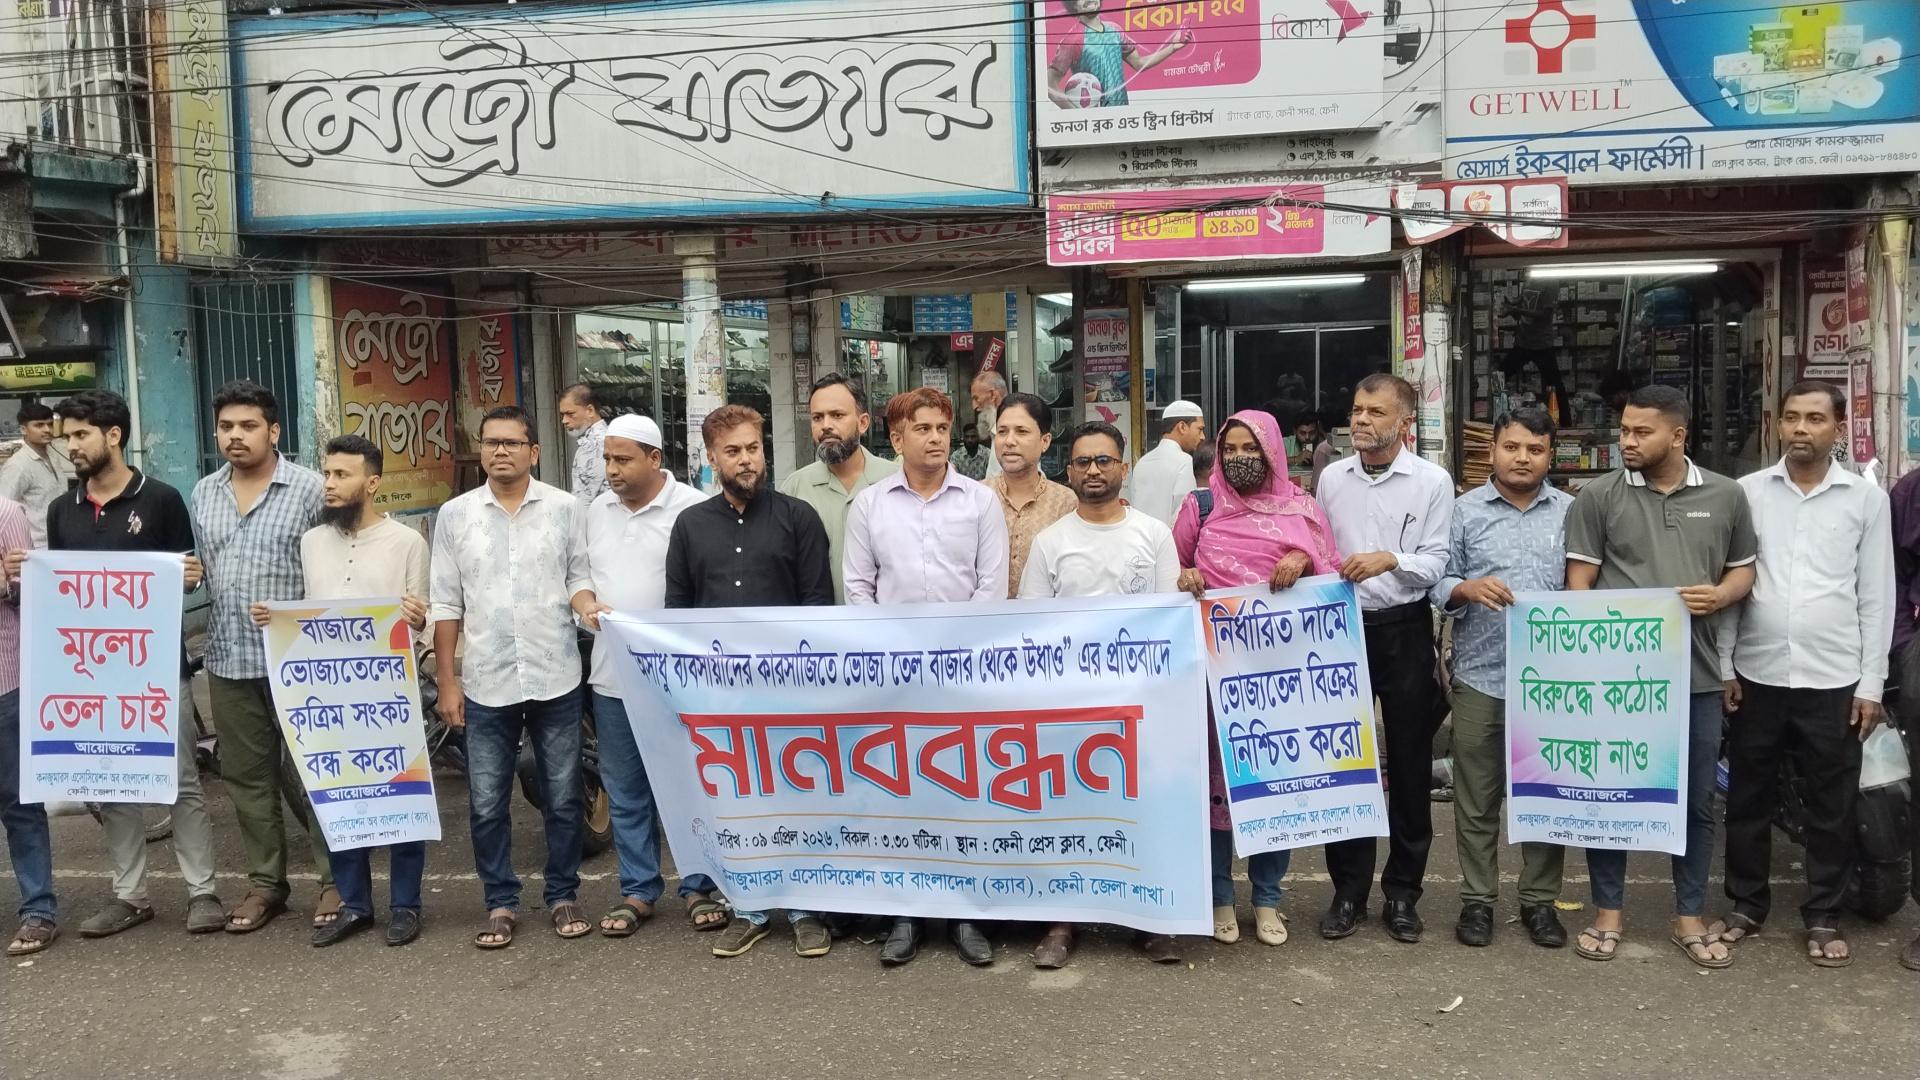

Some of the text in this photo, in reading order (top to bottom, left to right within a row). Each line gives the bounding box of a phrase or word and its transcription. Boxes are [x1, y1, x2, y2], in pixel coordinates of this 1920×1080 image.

[1272, 12, 1330, 39] বিকাশ
[267, 28, 996, 187] মেট্রো বাজার
[1050, 119, 1087, 134] জনতা
[1091, 118, 1114, 134] ব্লক
[1118, 115, 1141, 129] এন্ড
[1171, 108, 1213, 127] প্রিন্টার্স
[1469, 88, 1631, 117] GETWELL
[1457, 135, 1693, 180] মেসার্স ইকবাল ফার্মেসী
[192, 120, 222, 255] বাজার
[340, 292, 443, 384] মেট্রো
[478, 318, 504, 403] বাজার
[346, 400, 452, 466] বাজার
[53, 566, 156, 610] ন্যায্য
[297, 617, 376, 645] বাজারে
[1210, 599, 1350, 655] নির্ধারিত দামে
[1526, 605, 1665, 655] সিন্ডিকেটরের
[56, 627, 155, 680] মূল্যে
[281, 656, 407, 687] ভোজ্যতেলের
[672, 639, 753, 688] ব্যবসায়ীদের
[755, 639, 838, 688] কারসাজিতে
[843, 648, 885, 688] ভোজ্য
[890, 649, 924, 688] তেল
[928, 646, 974, 688] বাজার
[979, 641, 1018, 684] থেকে
[1078, 642, 1101, 680] এর
[1106, 627, 1171, 680] প্রতিবাদে
[1219, 651, 1359, 715] ভোজ্যতেল বিক্রয়
[1520, 664, 1671, 715] বিরুদ্ধে কঠোর
[39, 682, 171, 735] তেল চাই
[286, 692, 411, 746] কৃত্রিম সংকট
[303, 744, 406, 780] বন্ধ করো
[678, 705, 1144, 814] মানববন্ধন
[1228, 717, 1363, 777] নিশ্চিত করো
[1537, 736, 1648, 782] ব্যবস্থা নাও
[67, 785, 89, 797] ফেনী
[92, 788, 116, 797] জেলা
[350, 832, 376, 843] জেলা
[771, 825, 799, 848] এপ্রিল
[840, 826, 870, 848] বিকাল
[881, 834, 909, 850] ৩.৩০
[954, 834, 978, 856] স্থান
[992, 831, 1024, 854] ফেনী
[1028, 835, 1055, 854] প্রেস
[1267, 826, 1343, 845] ফেনী জেলা শাখা
[1548, 830, 1573, 841] ফেনী
[1577, 833, 1603, 842] জেলা
[789, 863, 875, 889] এসোসিয়েশন
[881, 870, 905, 890] অব
[910, 870, 976, 892] বাংলাদেশ
[1049, 871, 1085, 896] ফেনী
[1090, 877, 1127, 898] জেলা
[1132, 882, 1164, 905] শাখা
